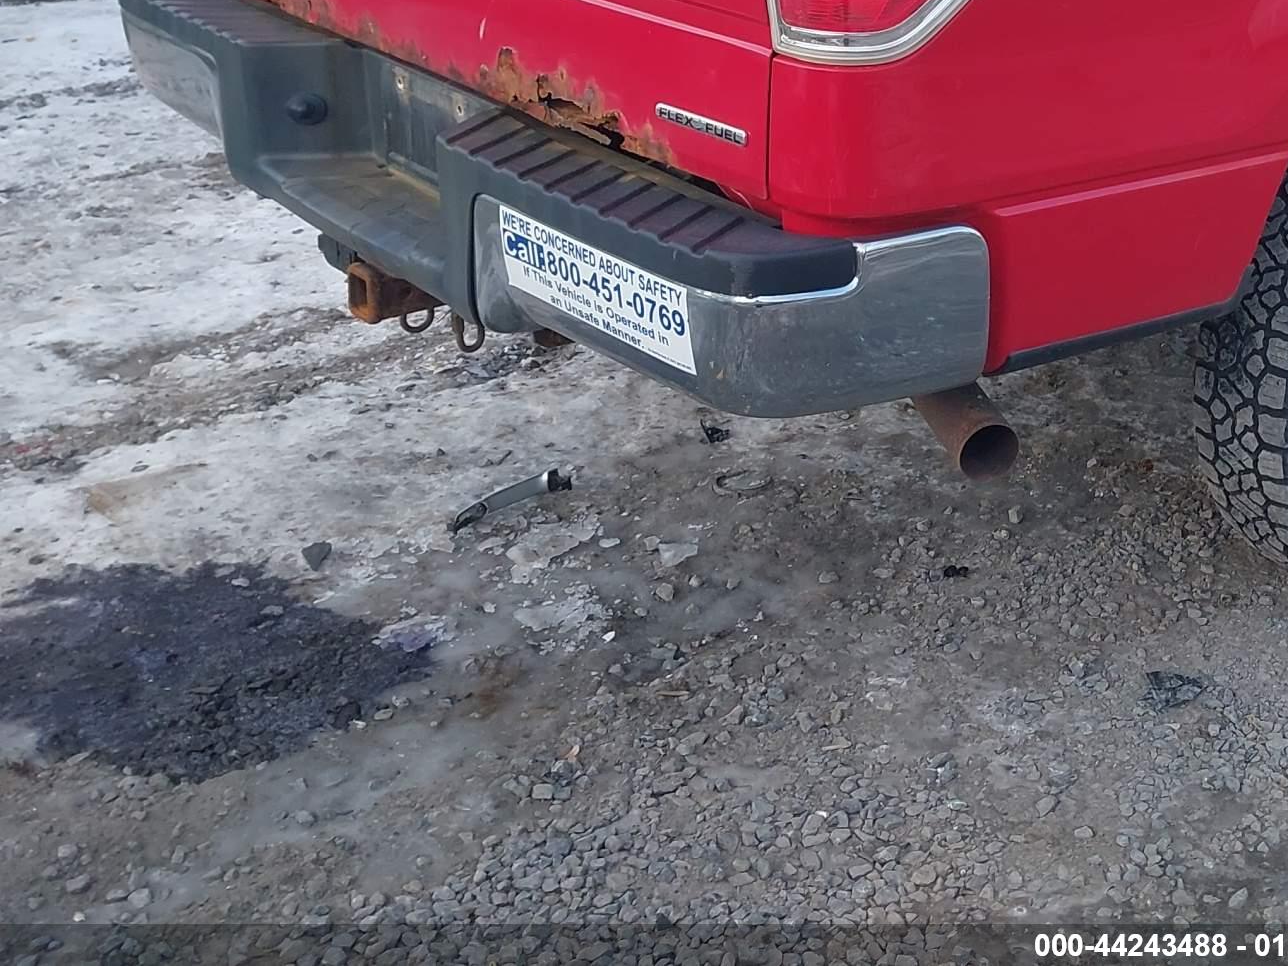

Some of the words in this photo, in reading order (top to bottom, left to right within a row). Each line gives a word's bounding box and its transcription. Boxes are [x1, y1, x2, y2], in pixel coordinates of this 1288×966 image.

[658, 106, 694, 130] FLEX
[705, 122, 746, 146] FUEL
[502, 209, 531, 237] WE'RE
[533, 225, 596, 268] CONCERNED
[599, 255, 635, 285] ABOUT
[638, 273, 682, 307] SAFETY
[546, 250, 686, 337] 800-451-0769
[523, 265, 531, 278] If
[533, 271, 553, 290] This
[555, 280, 592, 308] Vehicle
[606, 307, 656, 340] Operated
[550, 293, 563, 308] an
[564, 298, 600, 327] Unsafe
[602, 318, 646, 350] Manner.
